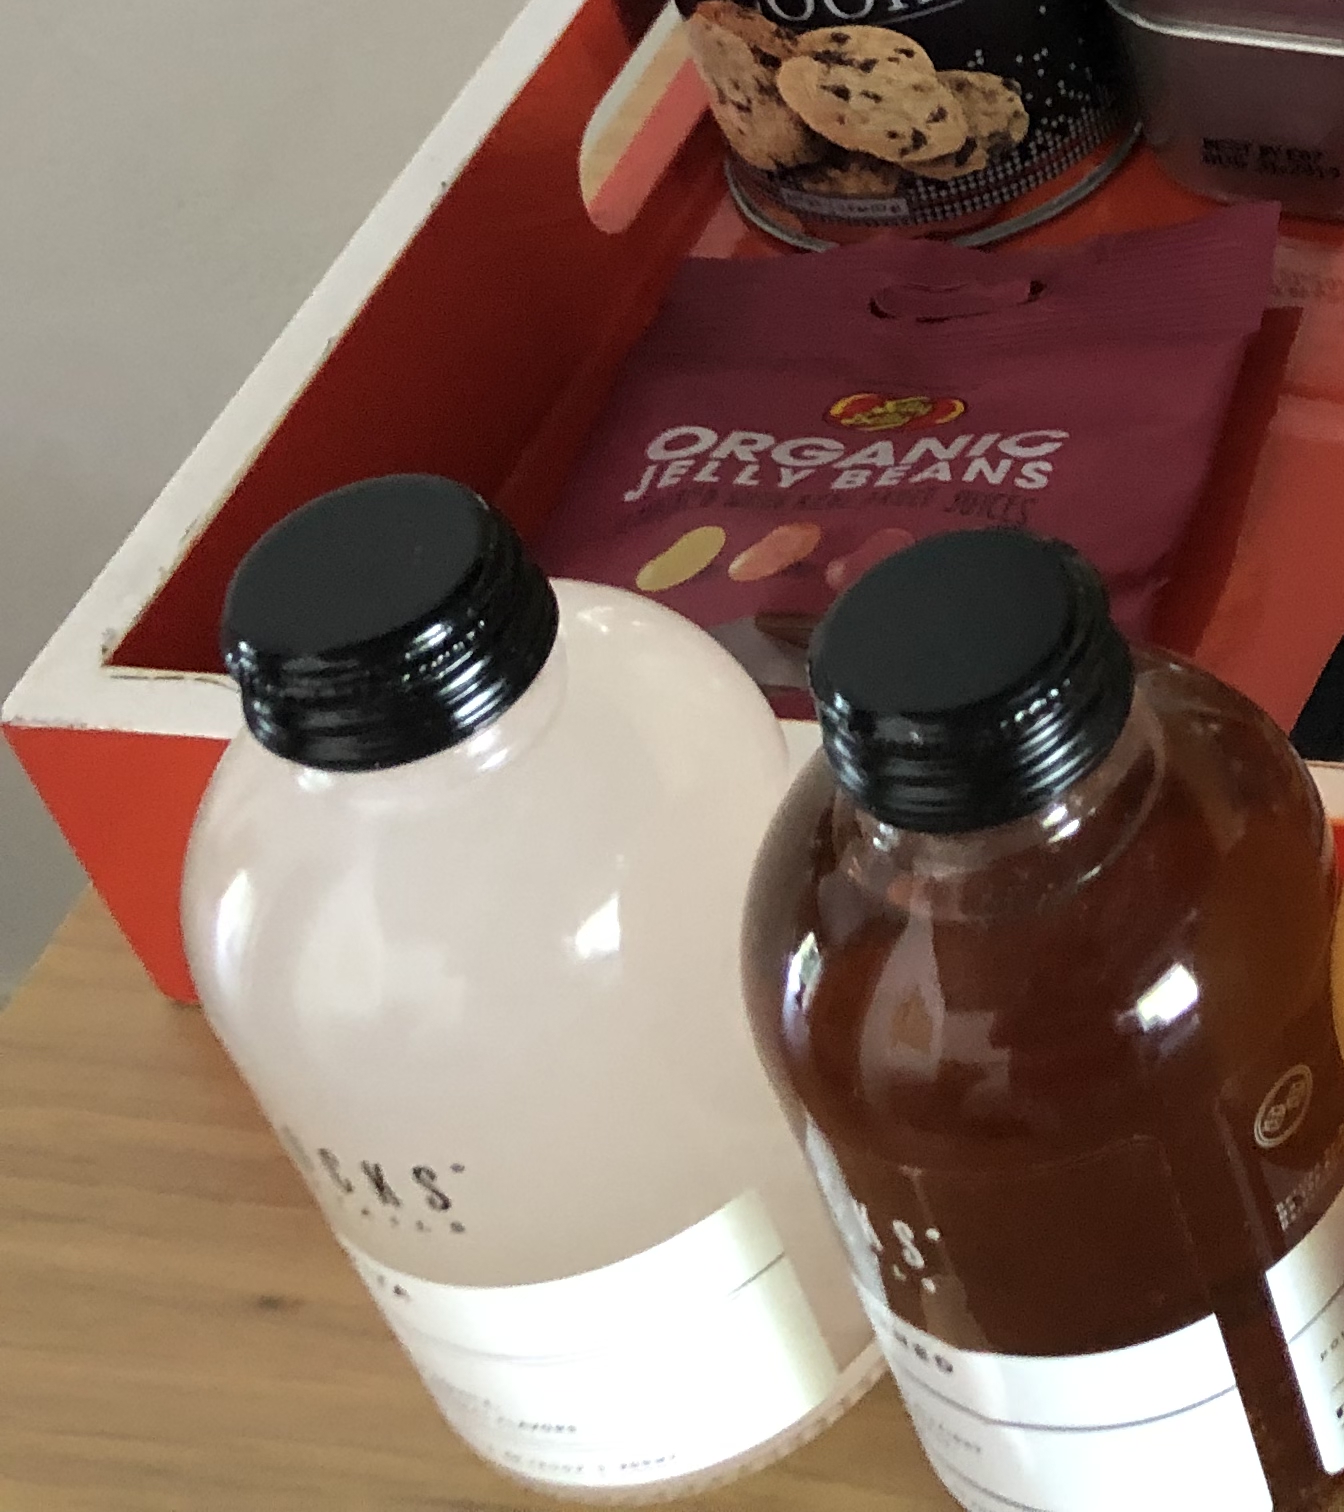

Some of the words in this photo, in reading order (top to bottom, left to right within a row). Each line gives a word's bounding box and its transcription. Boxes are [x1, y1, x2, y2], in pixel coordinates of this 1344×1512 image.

[645, 425, 1071, 469] ORGANIC
[623, 459, 816, 502] JELLY
[830, 456, 1055, 490] BEANS
